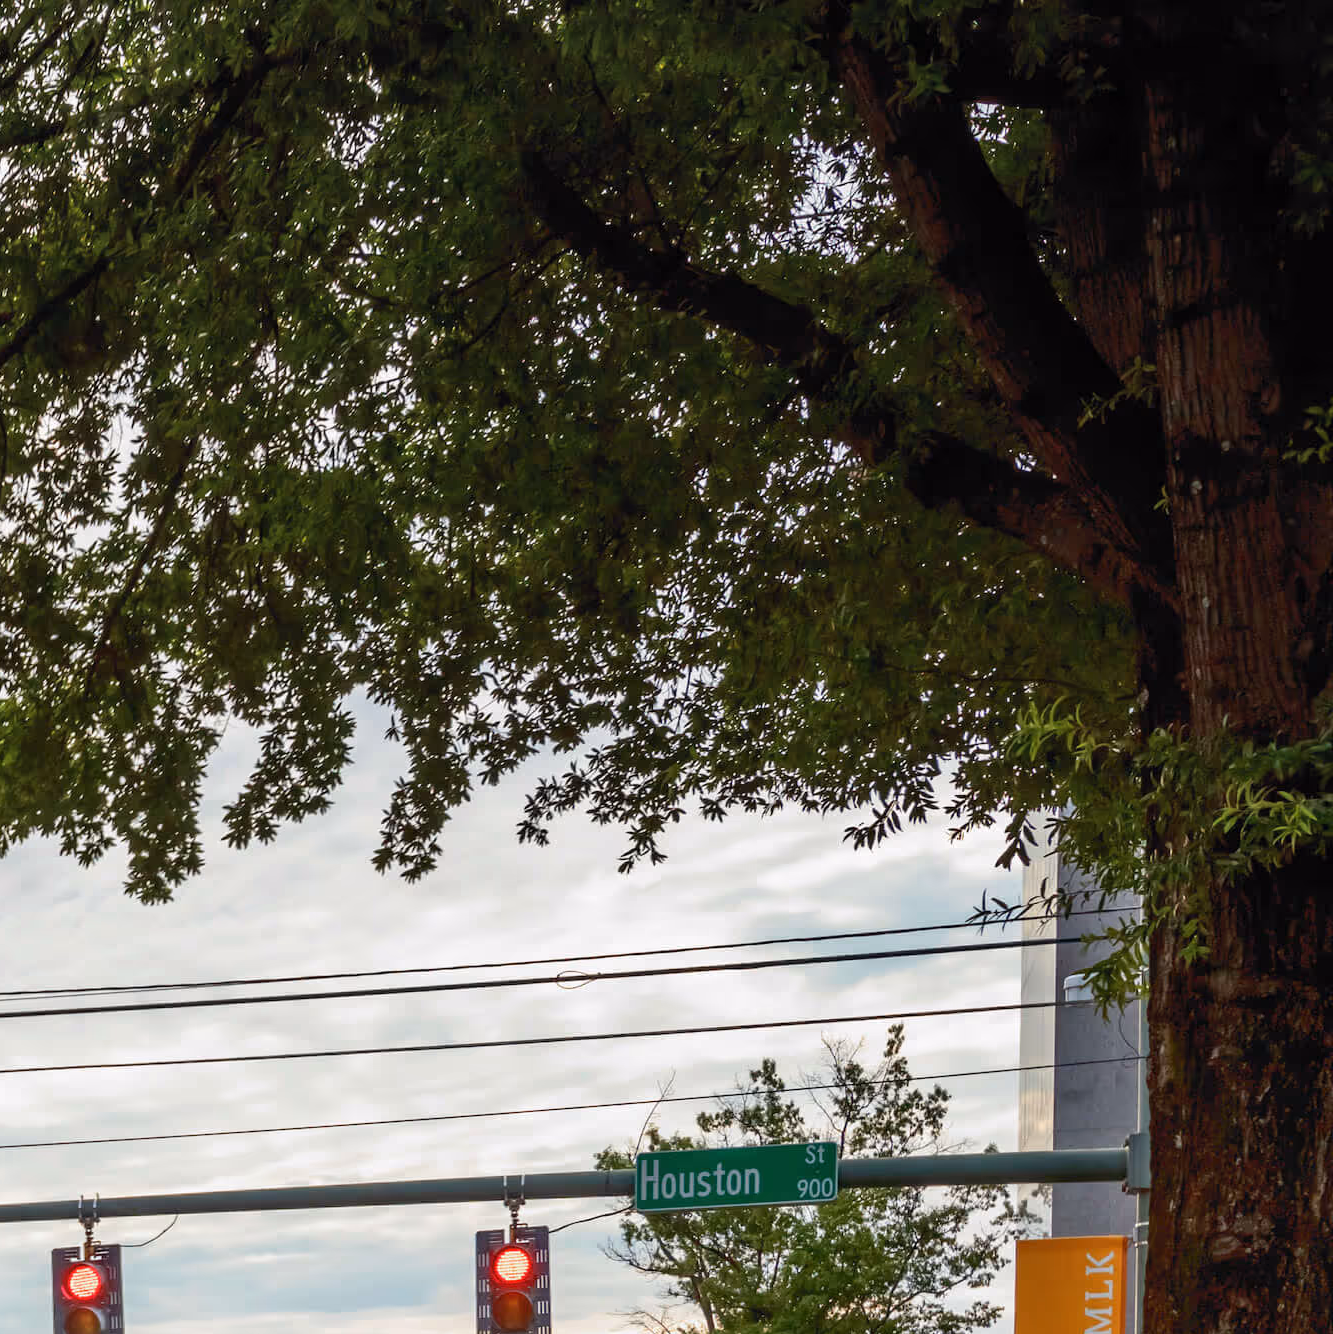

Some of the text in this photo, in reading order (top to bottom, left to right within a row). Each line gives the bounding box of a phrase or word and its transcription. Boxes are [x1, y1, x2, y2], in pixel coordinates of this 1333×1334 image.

[805, 1145, 825, 1165] St
[641, 1160, 760, 1200] Houston
[797, 1177, 833, 1199] 900
